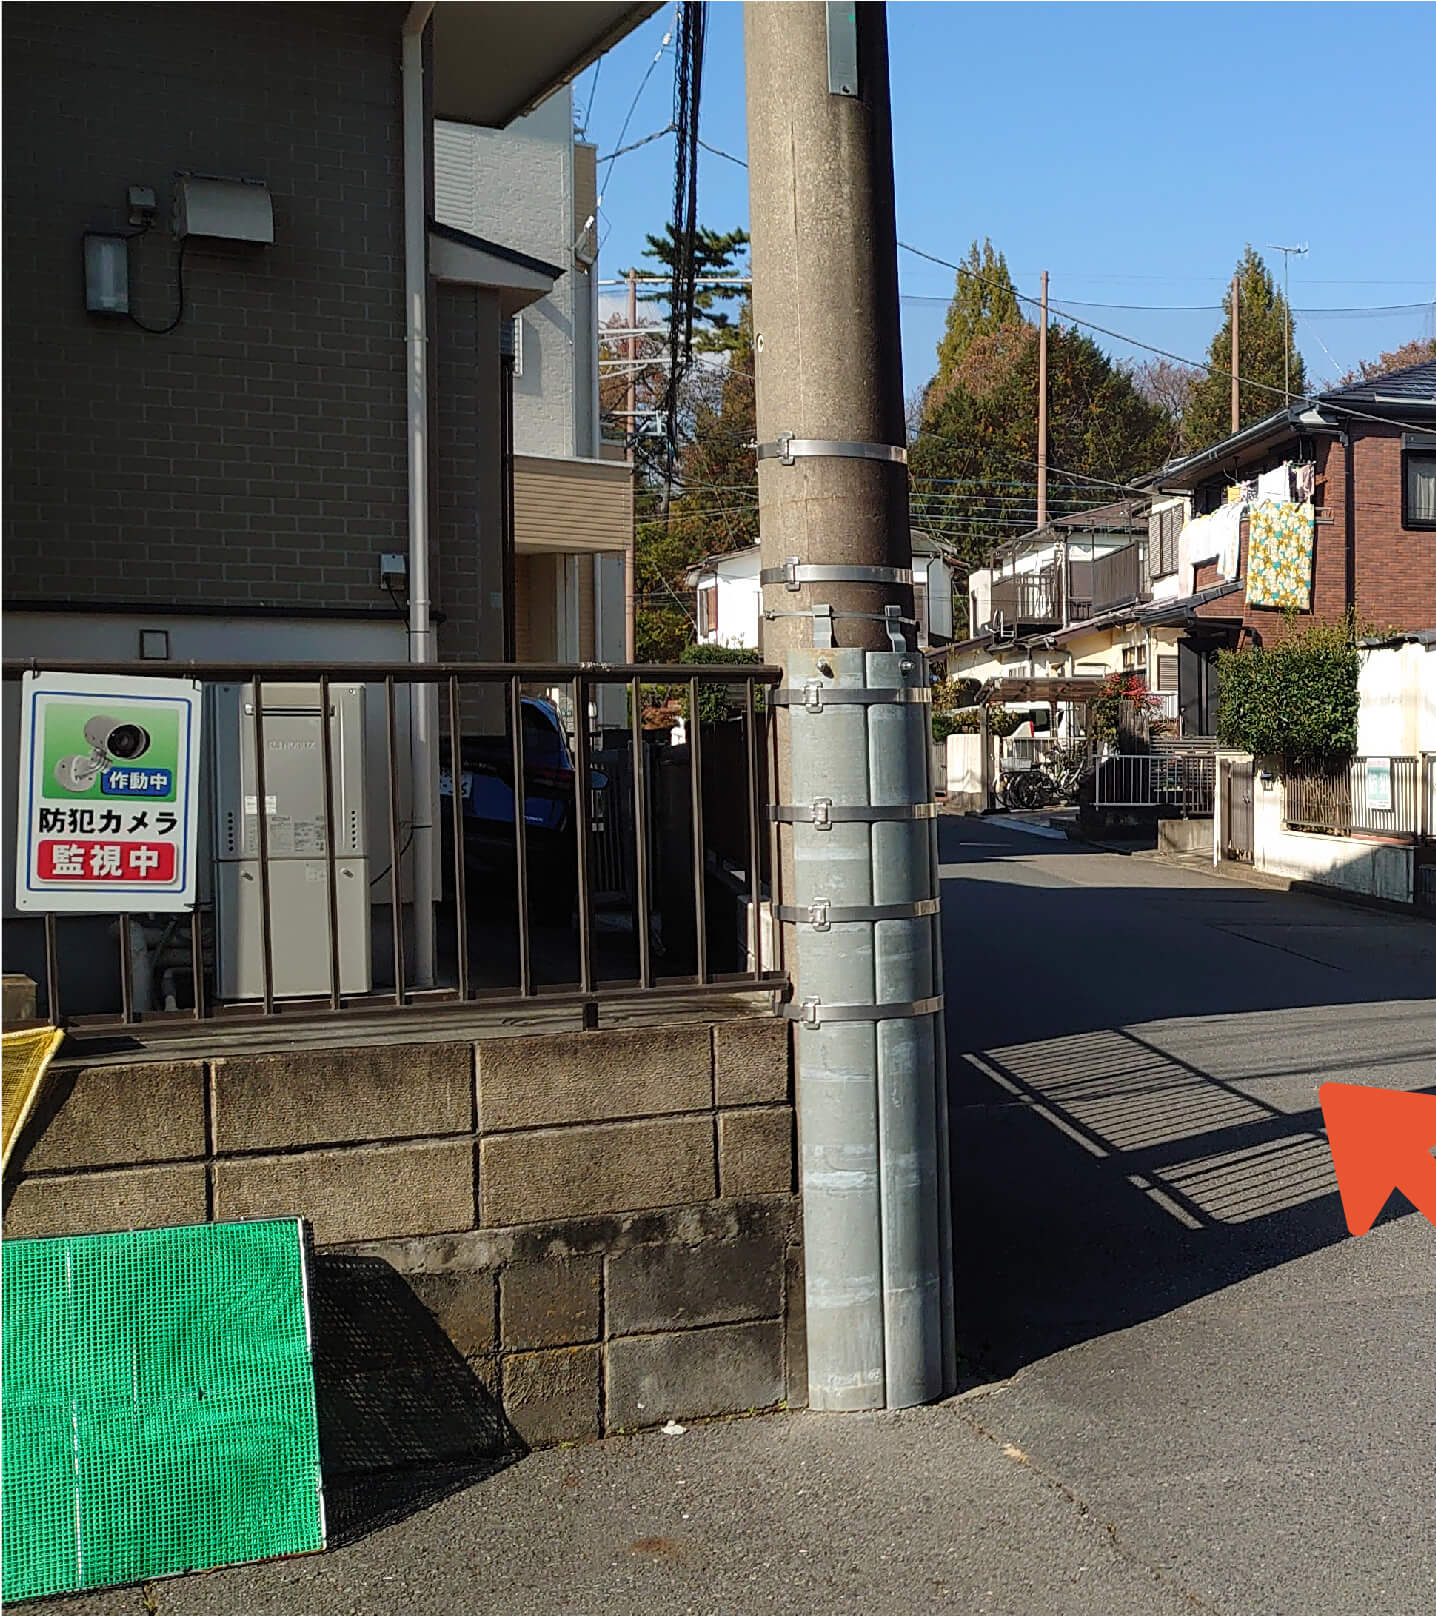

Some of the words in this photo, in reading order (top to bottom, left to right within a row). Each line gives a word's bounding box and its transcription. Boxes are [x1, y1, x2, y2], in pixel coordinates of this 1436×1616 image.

[109, 771, 168, 790] 作動中
[38, 807, 178, 835] 防犯カメラ
[52, 843, 160, 877] 監視中
